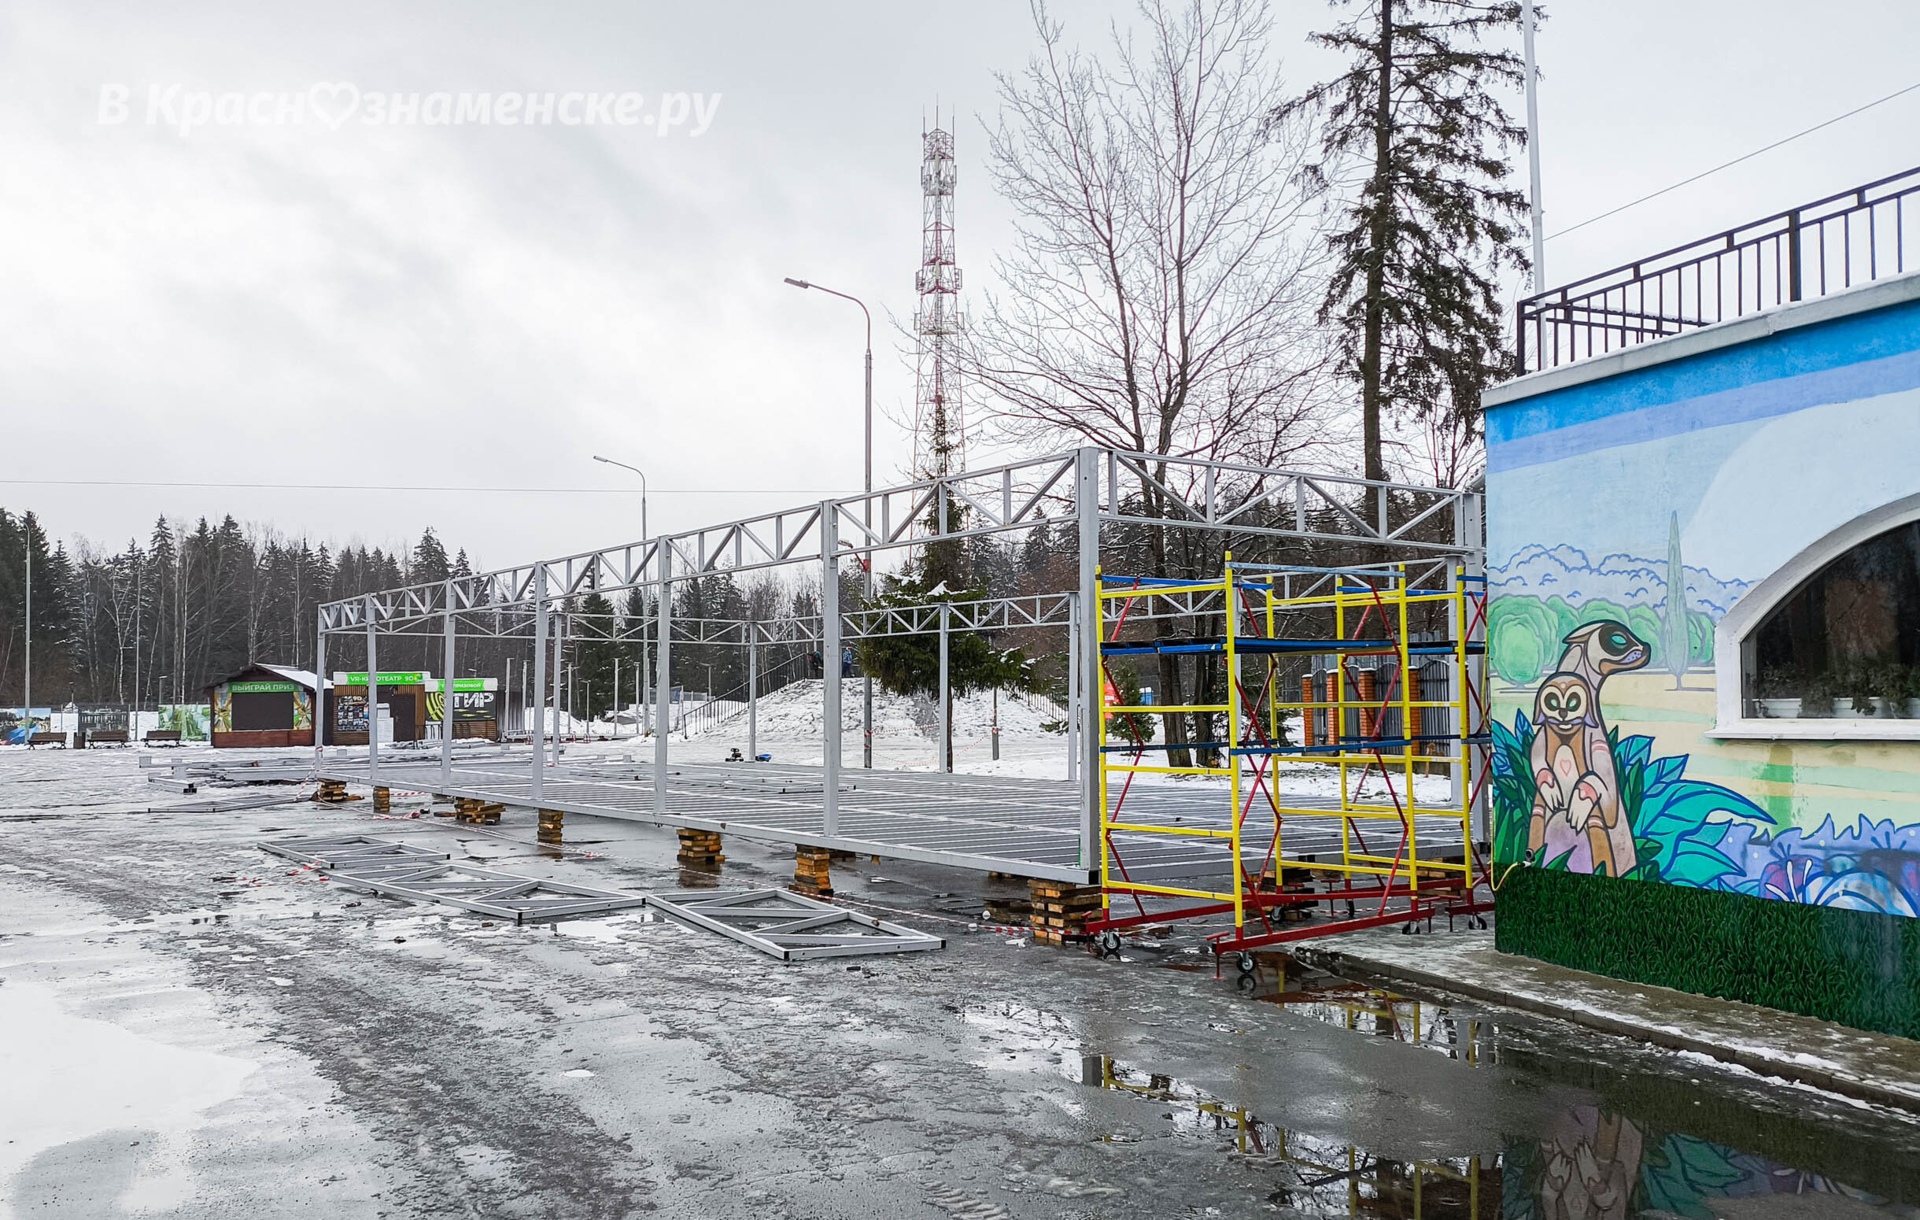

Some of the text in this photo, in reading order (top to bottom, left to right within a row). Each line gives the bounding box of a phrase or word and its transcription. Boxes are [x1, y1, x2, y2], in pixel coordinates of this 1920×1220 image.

[232, 683, 294, 691] ВЫИГРАЙ ПРИЗ
[453, 692, 494, 708] ТИР
